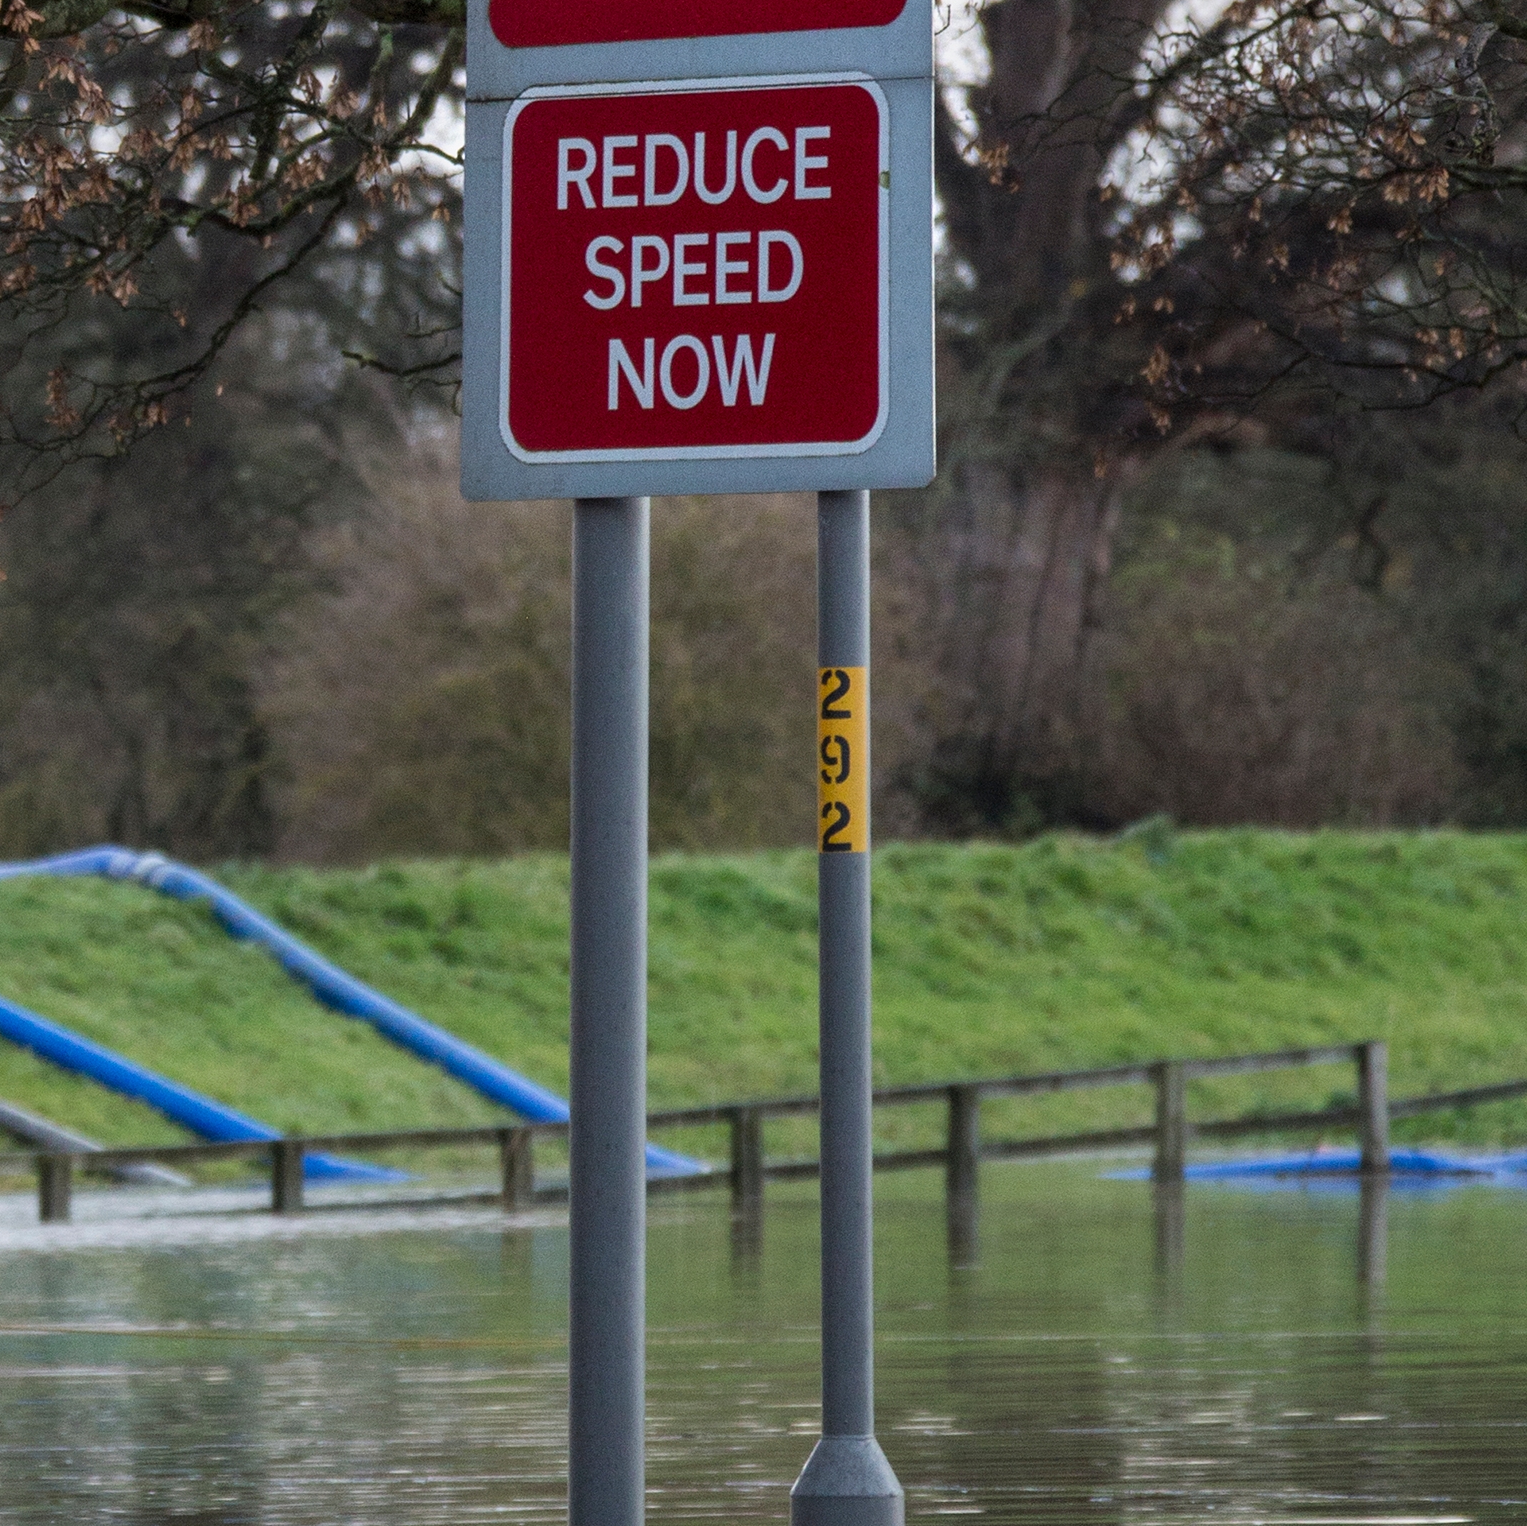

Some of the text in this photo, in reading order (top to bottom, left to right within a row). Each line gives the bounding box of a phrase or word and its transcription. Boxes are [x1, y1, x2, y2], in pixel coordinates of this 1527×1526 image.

[557, 125, 831, 210] REDUCE
[583, 230, 804, 310] SPEED
[607, 333, 775, 410] NOW
[821, 670, 852, 852] 292
